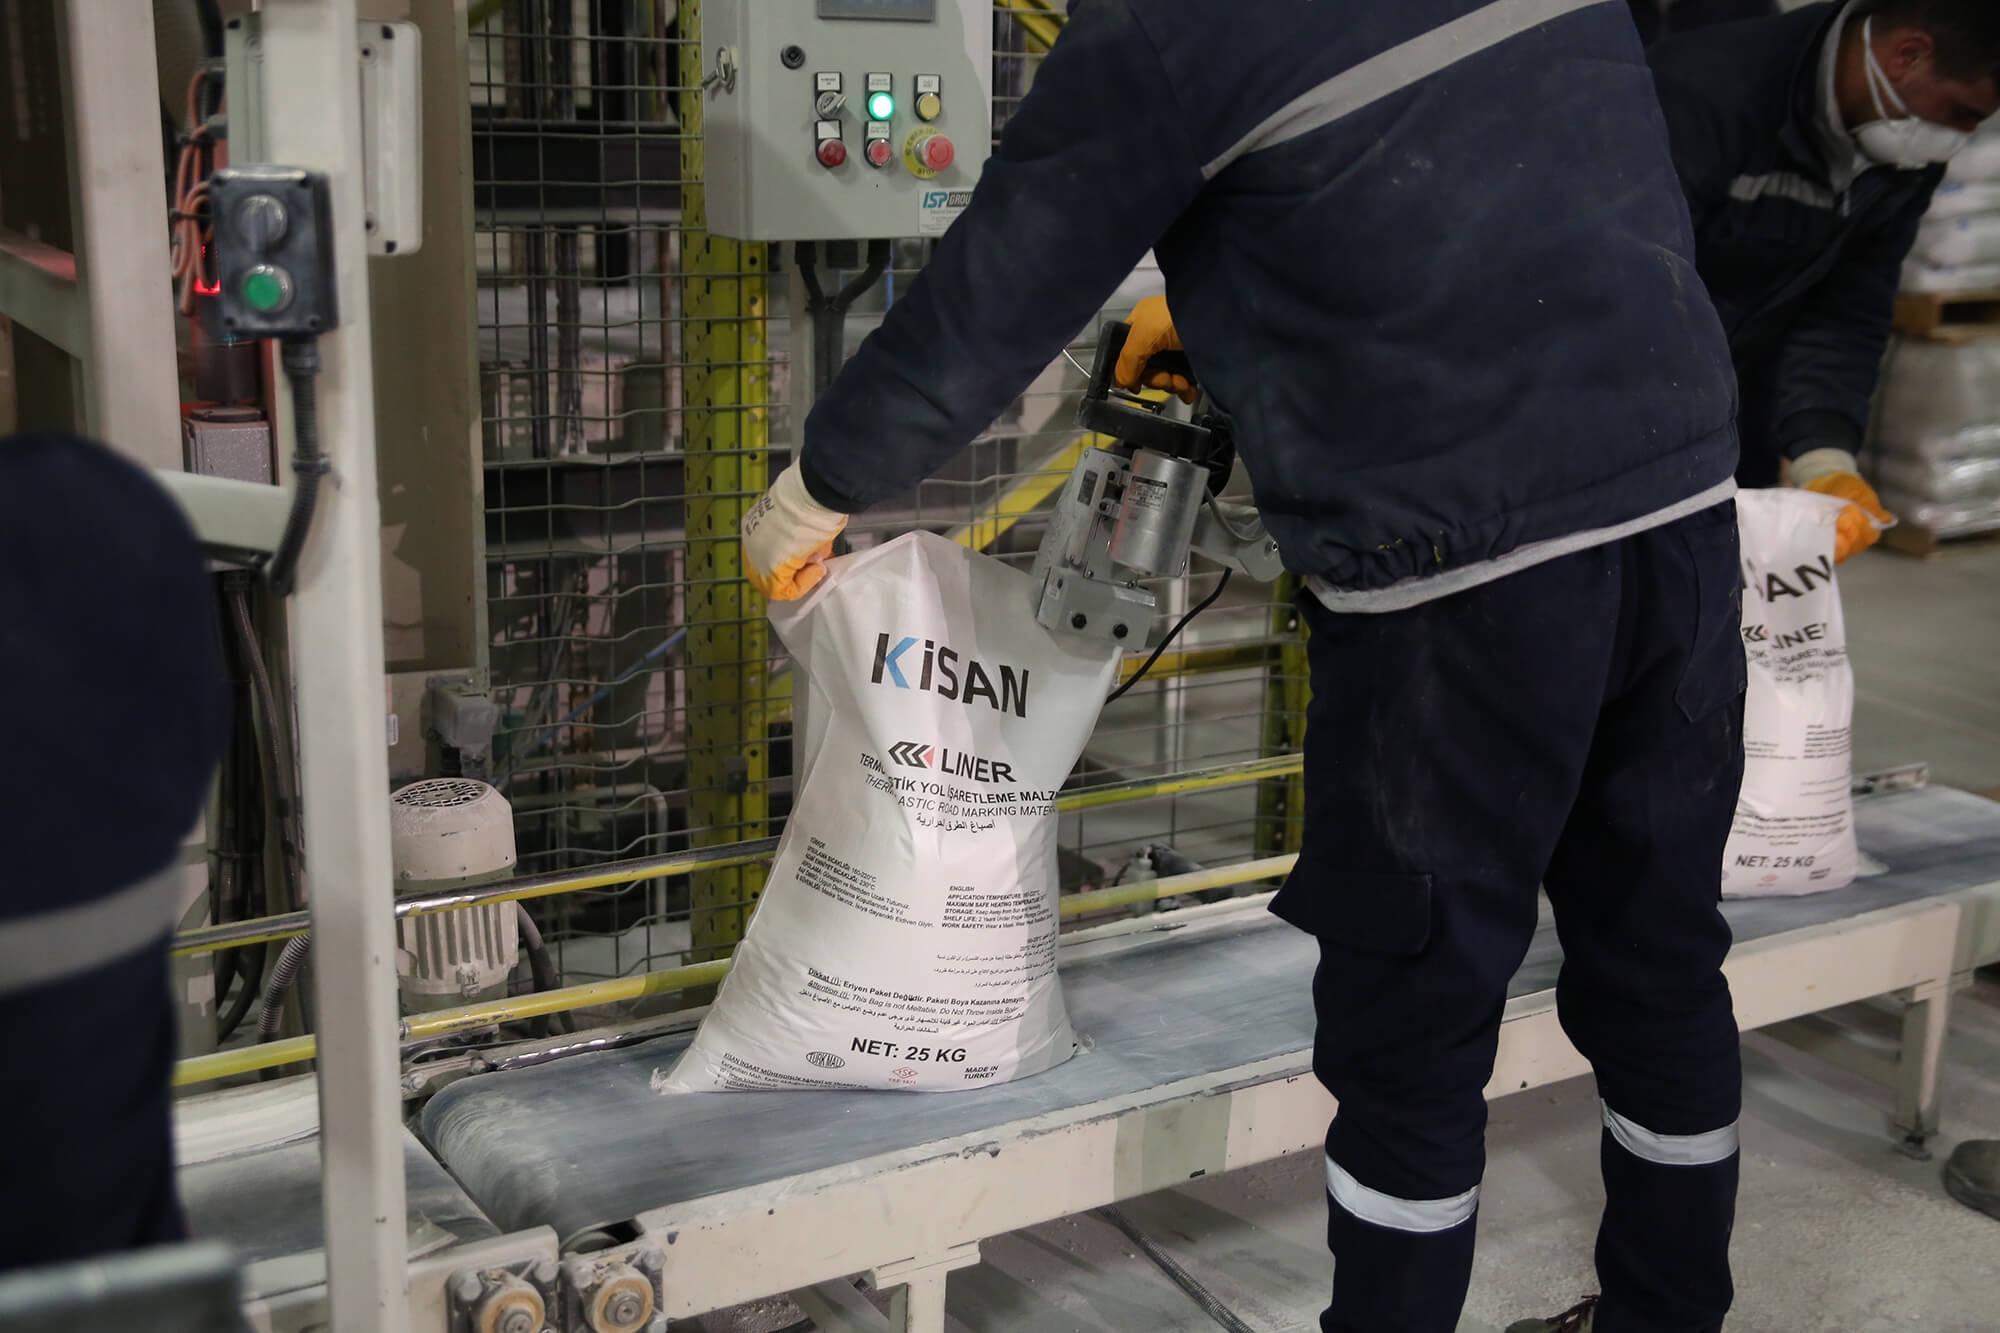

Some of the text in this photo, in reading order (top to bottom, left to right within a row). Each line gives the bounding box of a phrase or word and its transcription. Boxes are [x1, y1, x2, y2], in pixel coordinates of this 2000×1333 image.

[923, 191, 971, 208] ISP GROU
[941, 749, 1016, 782] LINER
[921, 782, 946, 797] YOL
[1020, 790, 1059, 801] MALZ
[938, 801, 959, 817] ROAD
[962, 806, 1016, 817] MARKING
[1735, 855, 1815, 867] NET: 25 KG
[808, 967, 830, 982] Dikkat
[843, 981, 868, 992] Eriyen
[869, 987, 891, 998] Paket
[950, 998, 969, 1007] Boya
[808, 980, 838, 996] Attention
[852, 994, 867, 1003] This
[868, 998, 883, 1008] Bag
[851, 1037, 966, 1062] NET: 25 KG
